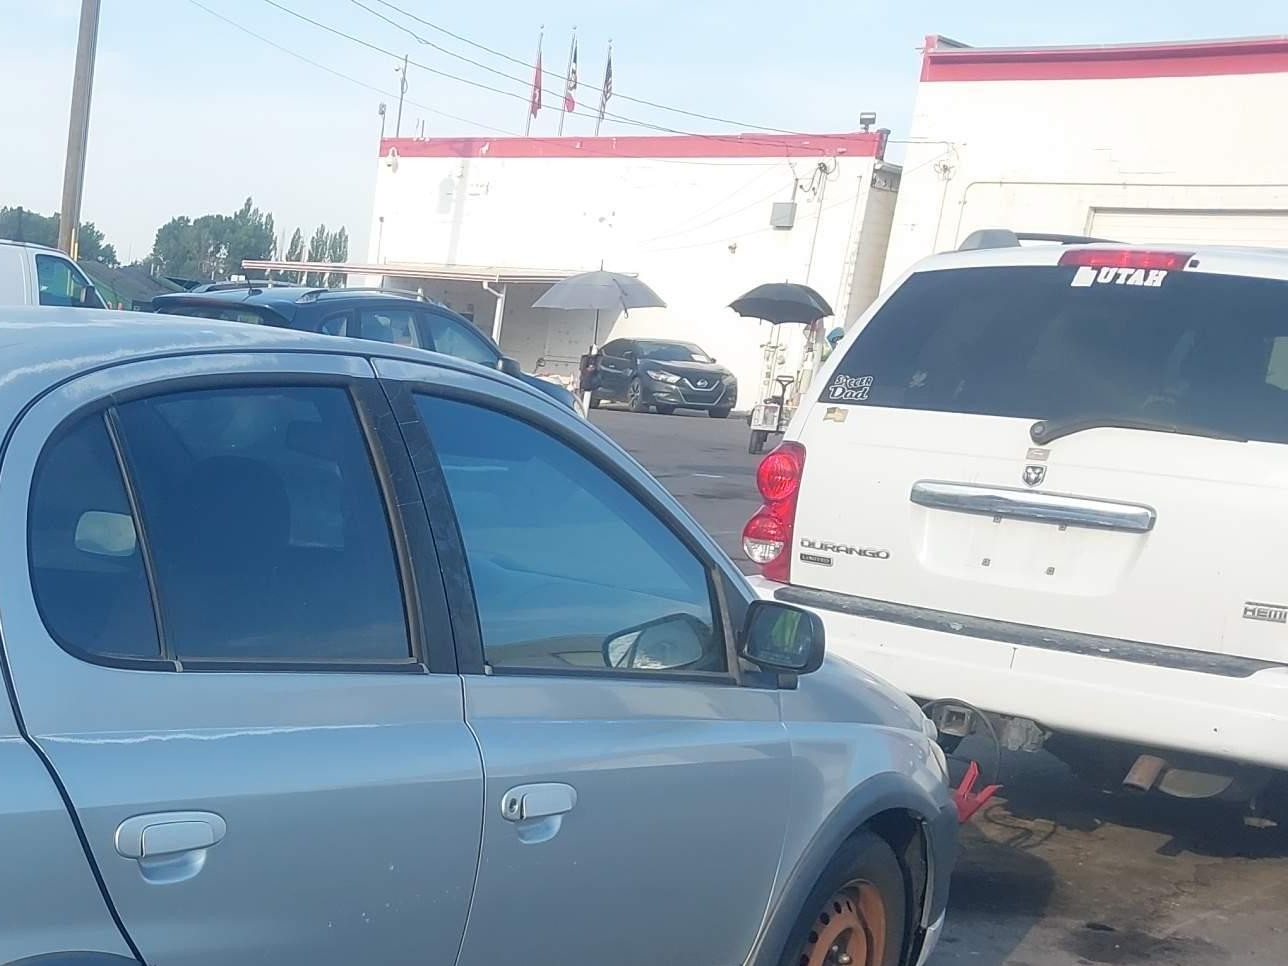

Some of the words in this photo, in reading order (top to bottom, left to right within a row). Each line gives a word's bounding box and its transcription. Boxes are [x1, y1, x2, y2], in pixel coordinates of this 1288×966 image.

[1097, 266, 1168, 287] UTAH
[829, 385, 870, 400] Dad
[800, 538, 889, 559] DURANGO
[1243, 606, 1287, 624] HEMI
